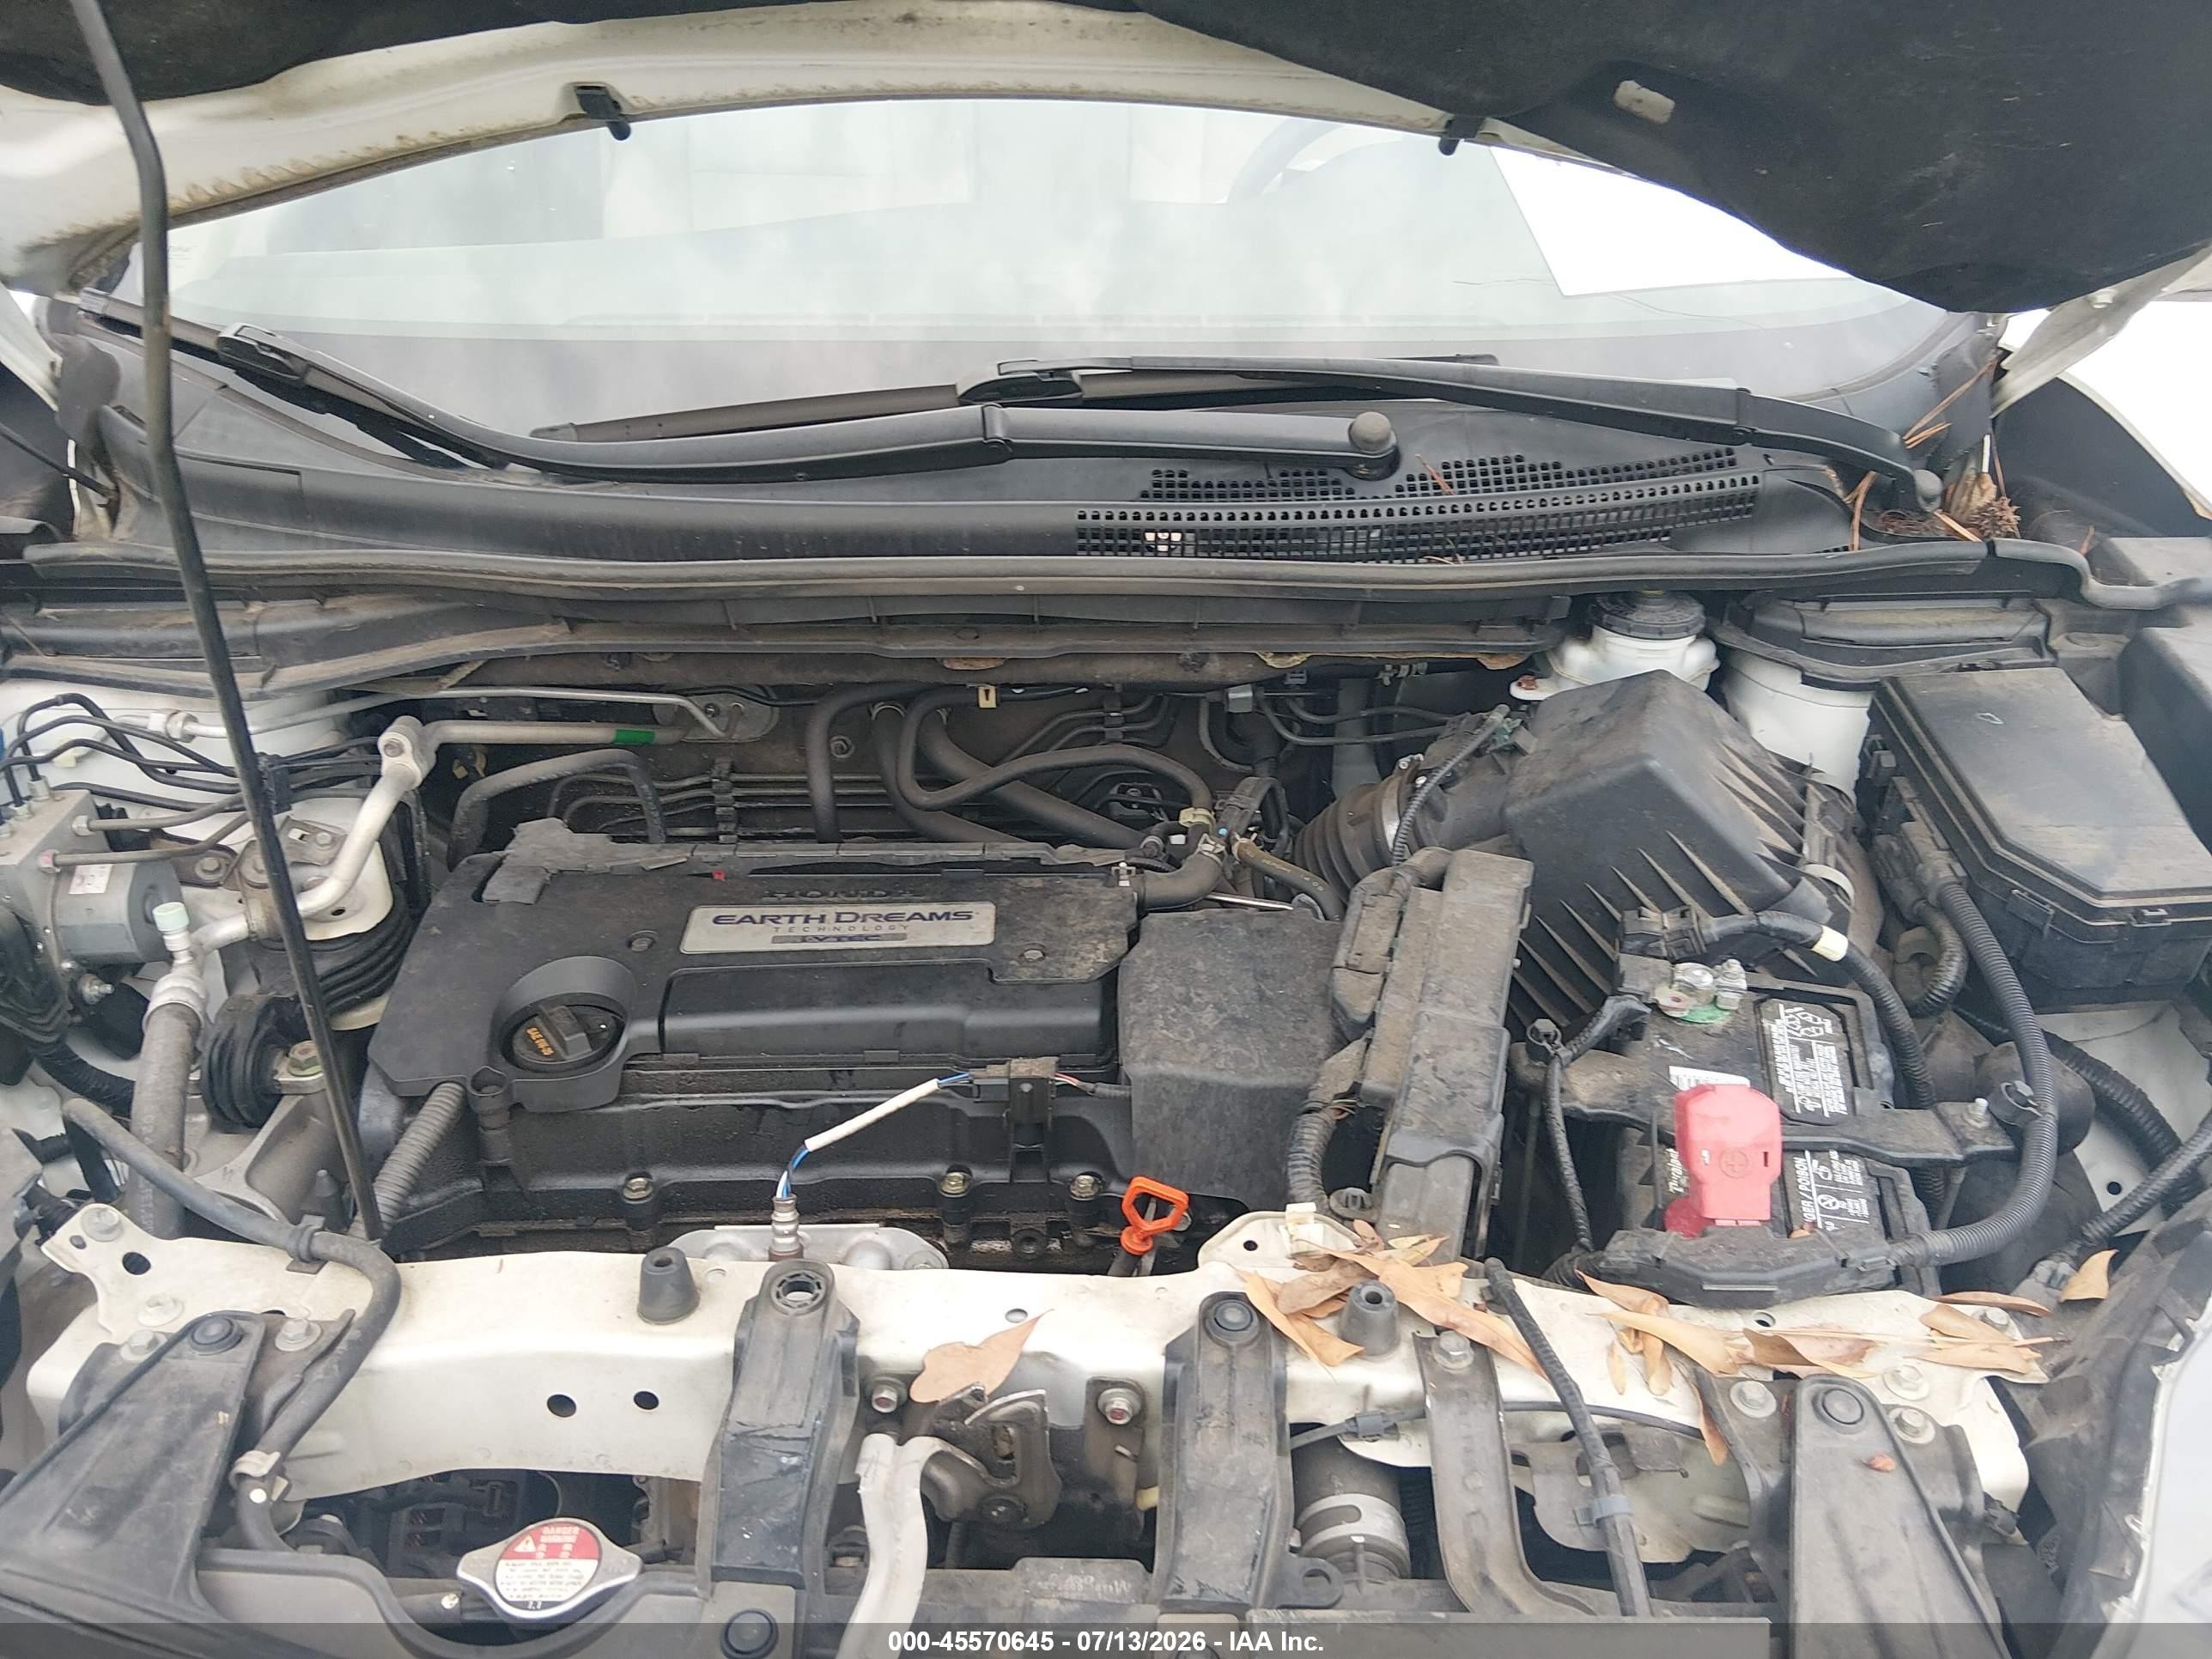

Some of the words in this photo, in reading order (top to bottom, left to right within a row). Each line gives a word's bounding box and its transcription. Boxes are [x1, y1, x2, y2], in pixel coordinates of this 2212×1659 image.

[712, 913, 826, 926] EARTH
[834, 910, 974, 923] DREAMS
[773, 924, 909, 933] TECHNOLOGY
[1792, 1156, 1813, 1192] POISON
